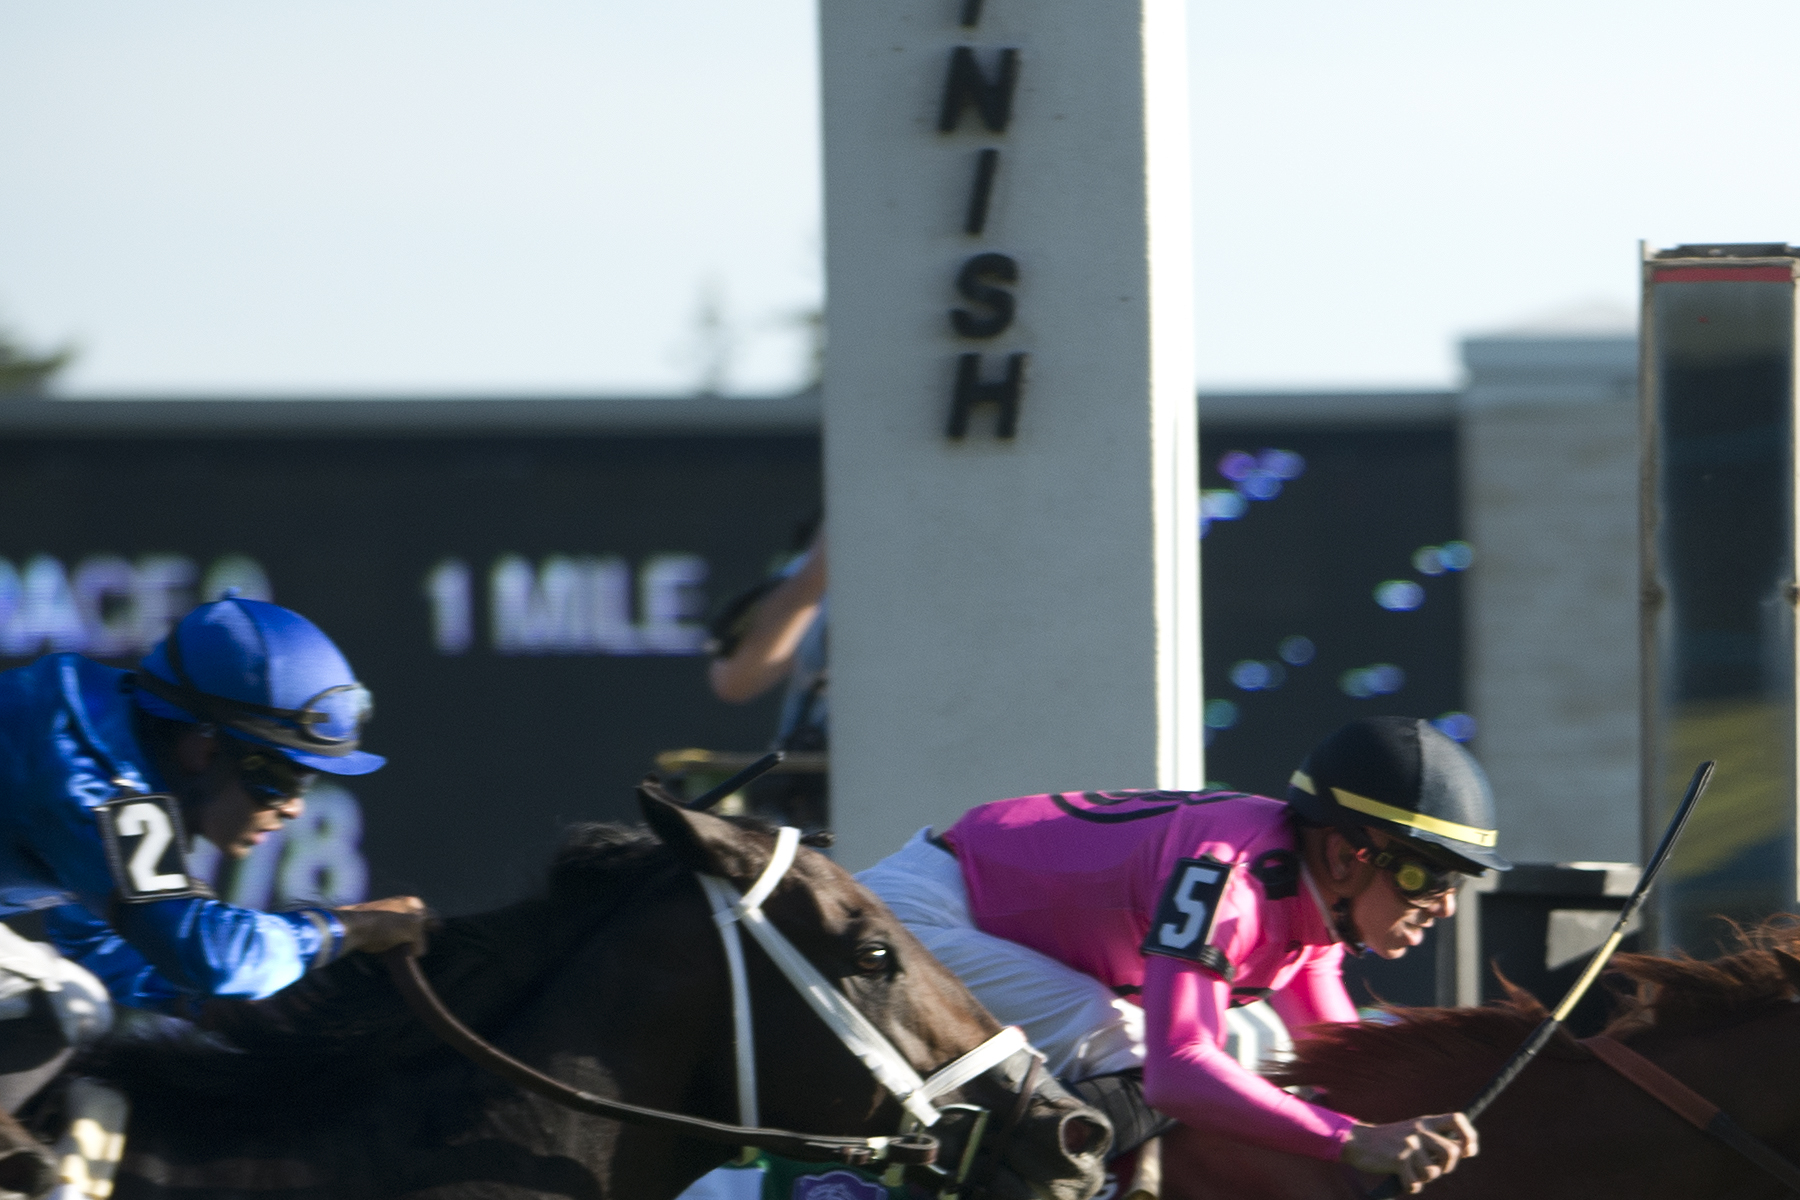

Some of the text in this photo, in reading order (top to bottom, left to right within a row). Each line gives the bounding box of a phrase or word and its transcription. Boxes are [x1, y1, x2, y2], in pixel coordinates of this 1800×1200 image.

[490, 554, 709, 655] MILE
[116, 803, 188, 892] 2
[1159, 866, 1221, 949] 5
